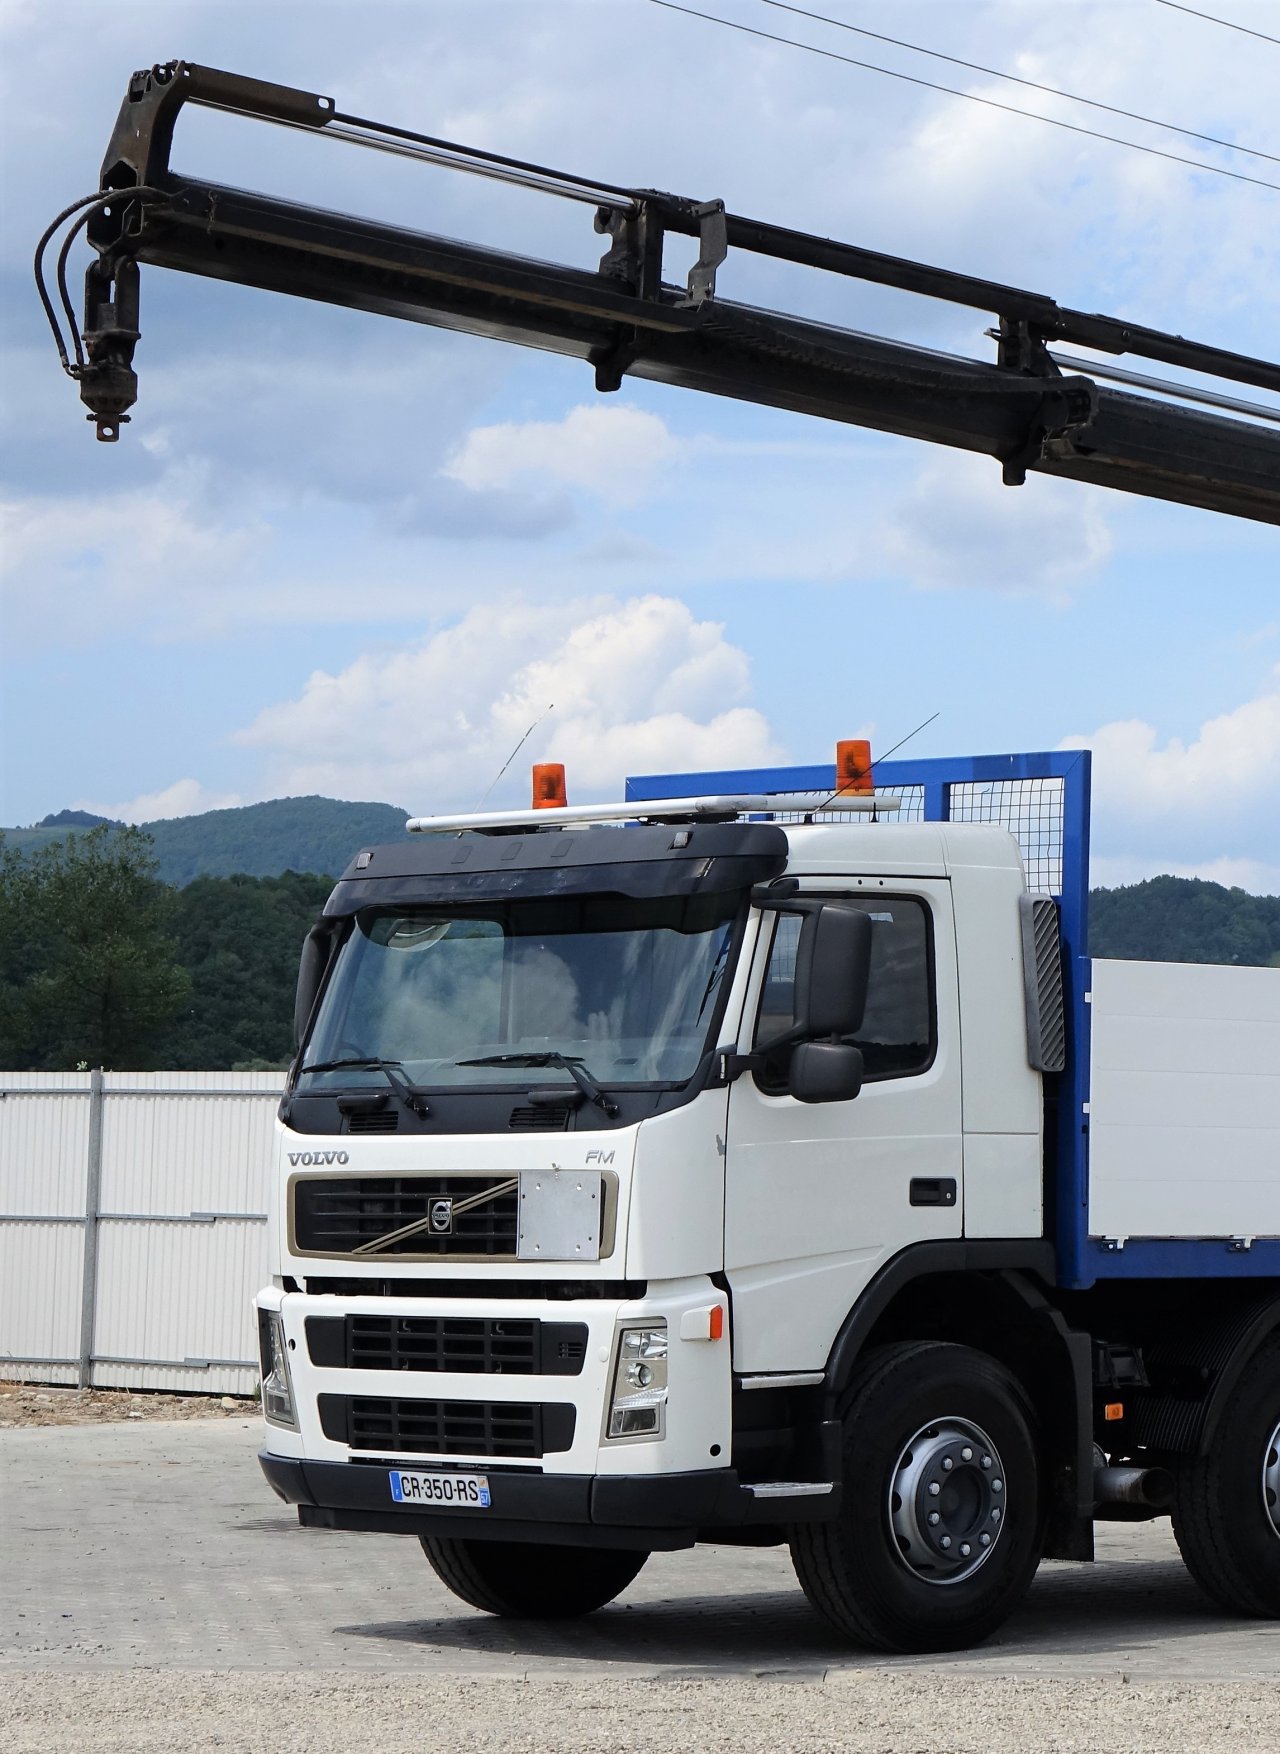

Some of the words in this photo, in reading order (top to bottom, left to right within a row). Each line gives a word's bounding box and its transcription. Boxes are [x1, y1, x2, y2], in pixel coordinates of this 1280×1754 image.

[287, 1150, 350, 1166] VOLVO
[585, 1149, 616, 1164] FM
[401, 1476, 479, 1502] CR-350-RS
